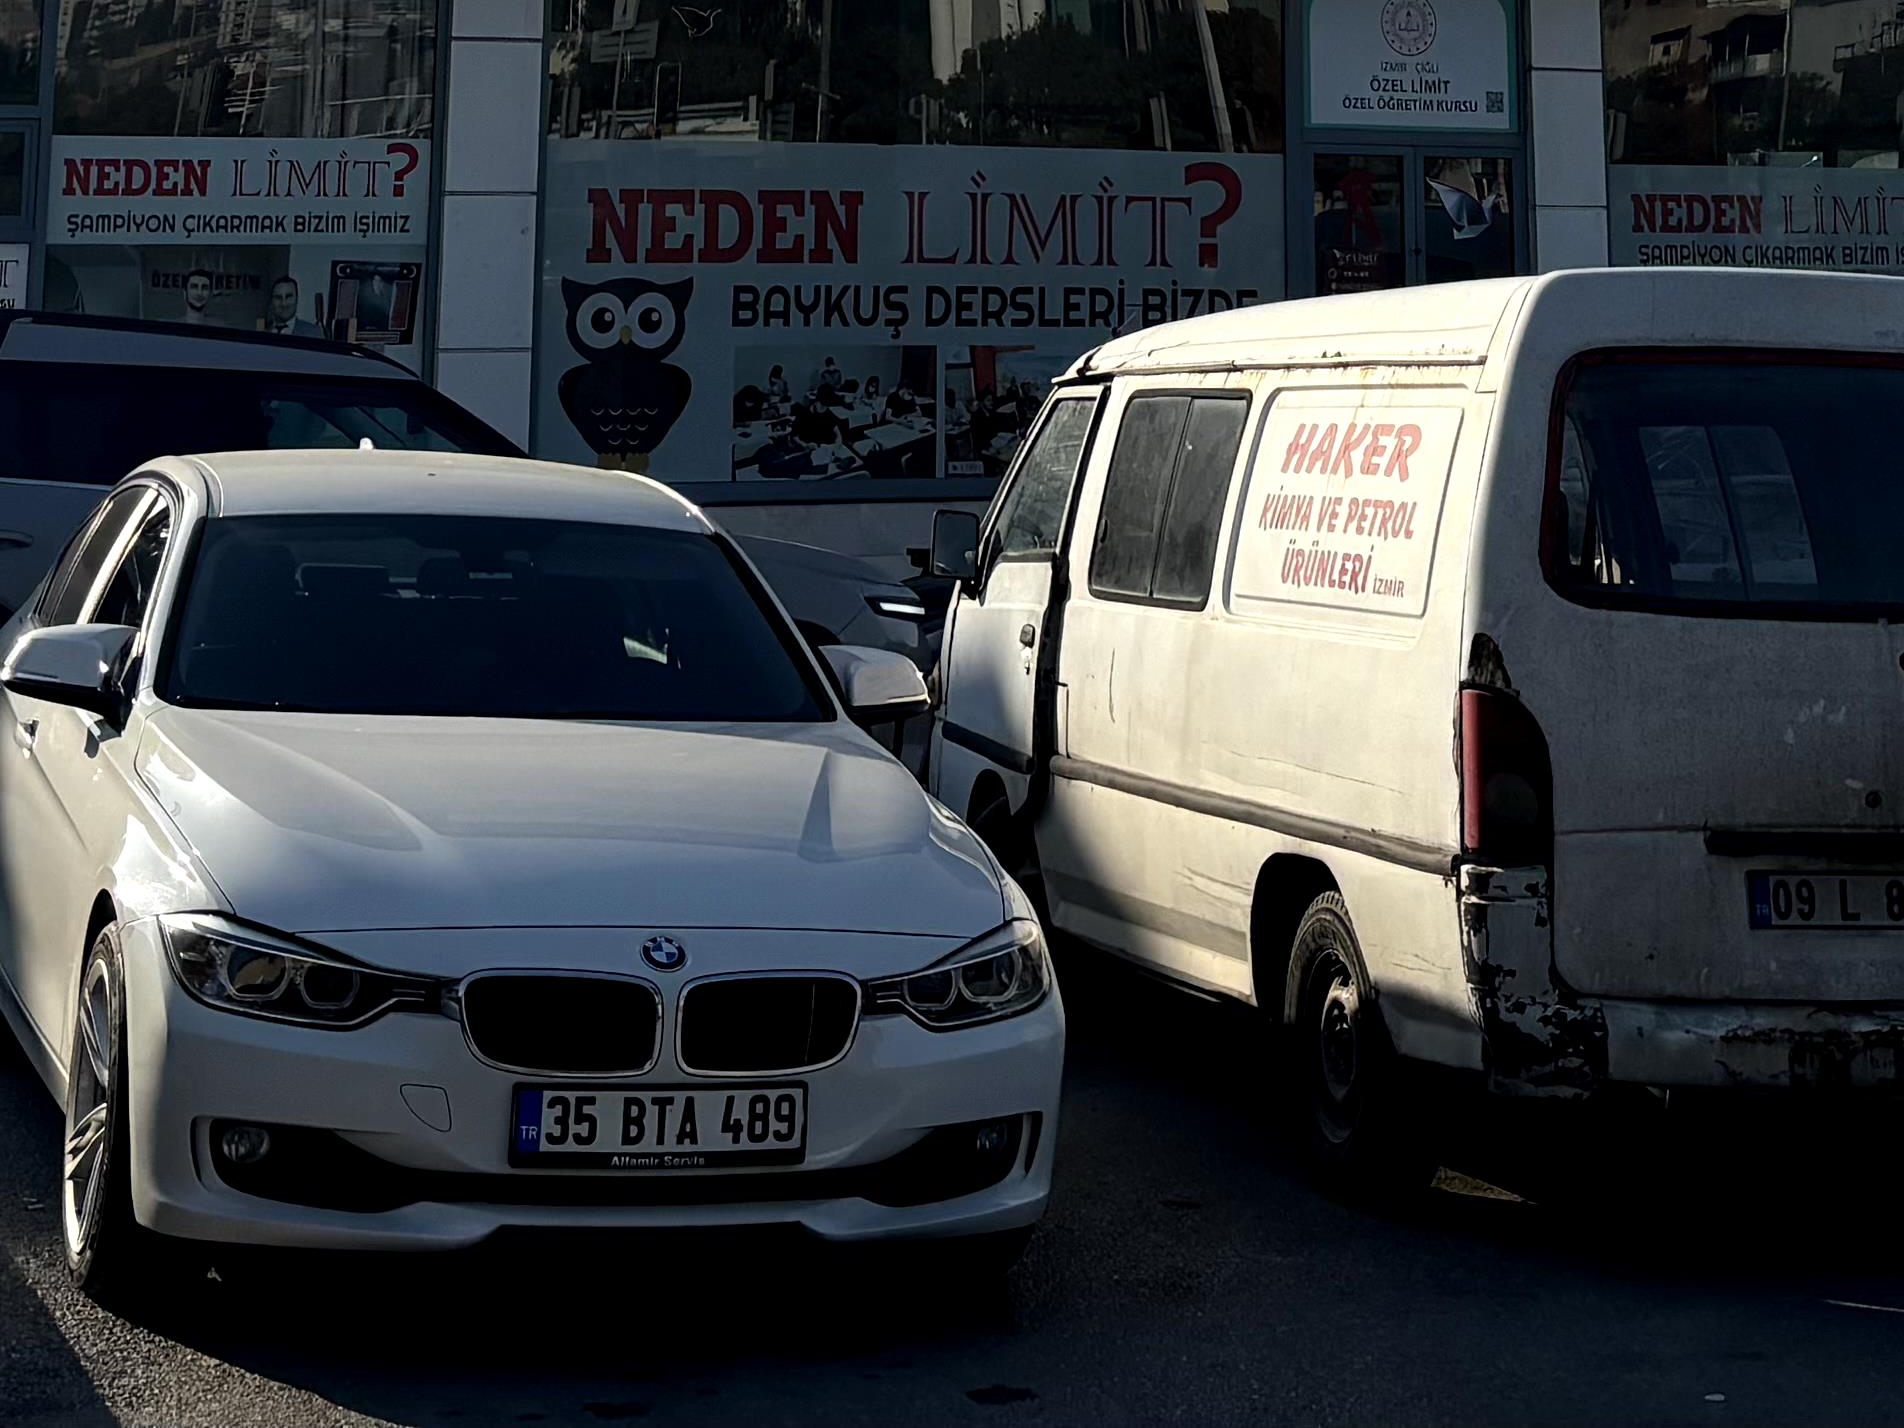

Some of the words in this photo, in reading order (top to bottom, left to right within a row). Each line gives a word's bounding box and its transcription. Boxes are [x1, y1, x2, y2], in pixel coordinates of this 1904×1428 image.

[1343, 97, 1373, 110] ÖZEL
[1377, 96, 1434, 112] ÖĞRETİM
[1437, 99, 1478, 112] KURSU
[1370, 75, 1407, 93] ÖZEL
[1411, 77, 1450, 94] LİMİT
[62, 158, 210, 196] NEDEN
[67, 210, 176, 238] ŞAMPİYON
[183, 213, 287, 238] ÇIKARMAK
[296, 211, 346, 234] BİZİM
[353, 211, 411, 238] İŞİMİZ
[586, 188, 864, 265] NEDEN
[1631, 193, 1763, 234] NEDEN
[1638, 240, 1737, 267] ŞAMPİYON
[1742, 244, 1835, 267] ÇIKARMAK
[1842, 242, 1889, 265] BİZİM
[731, 285, 910, 339] BAYKUŞ
[925, 279, 1125, 328] DERSLERİ
[1281, 423, 1422, 482] HAKER
[1259, 485, 1313, 531] KİMYA
[1317, 496, 1343, 533] VE
[1343, 497, 1416, 540] PETROL
[1281, 538, 1374, 594] ÜRÜNLERİ
[1772, 879, 1816, 921] 09
[1839, 879, 1860, 921] L
[520, 1125, 538, 1141] TR
[545, 1095, 597, 1145] 35
[621, 1096, 697, 1145] BTA
[721, 1094, 797, 1144] 489
